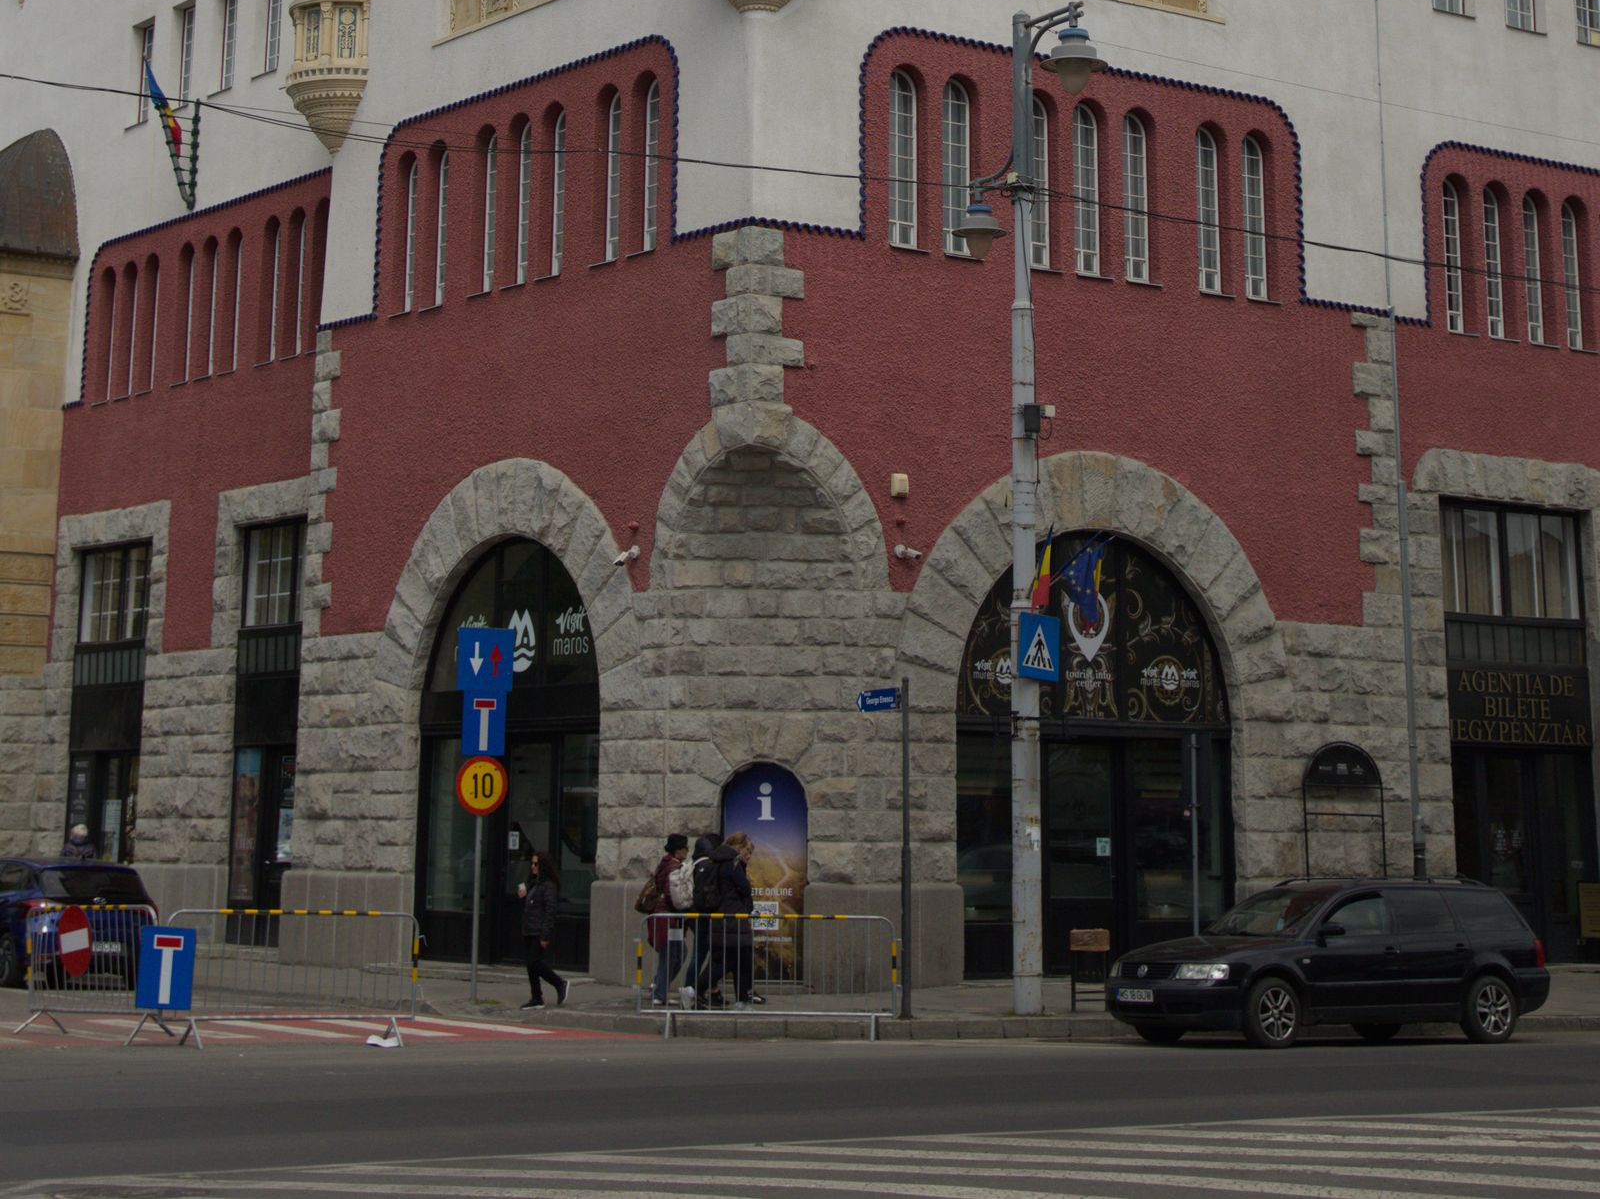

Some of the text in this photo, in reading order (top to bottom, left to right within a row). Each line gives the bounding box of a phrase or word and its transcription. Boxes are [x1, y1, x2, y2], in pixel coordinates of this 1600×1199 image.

[555, 605, 588, 635] Visit
[553, 635, 590, 657] maros
[1065, 669, 1112, 681] tourist info
[1075, 679, 1102, 688] center
[1549, 675, 1575, 697] DE
[1484, 696, 1552, 720] BILETE
[472, 772, 495, 799] 10
